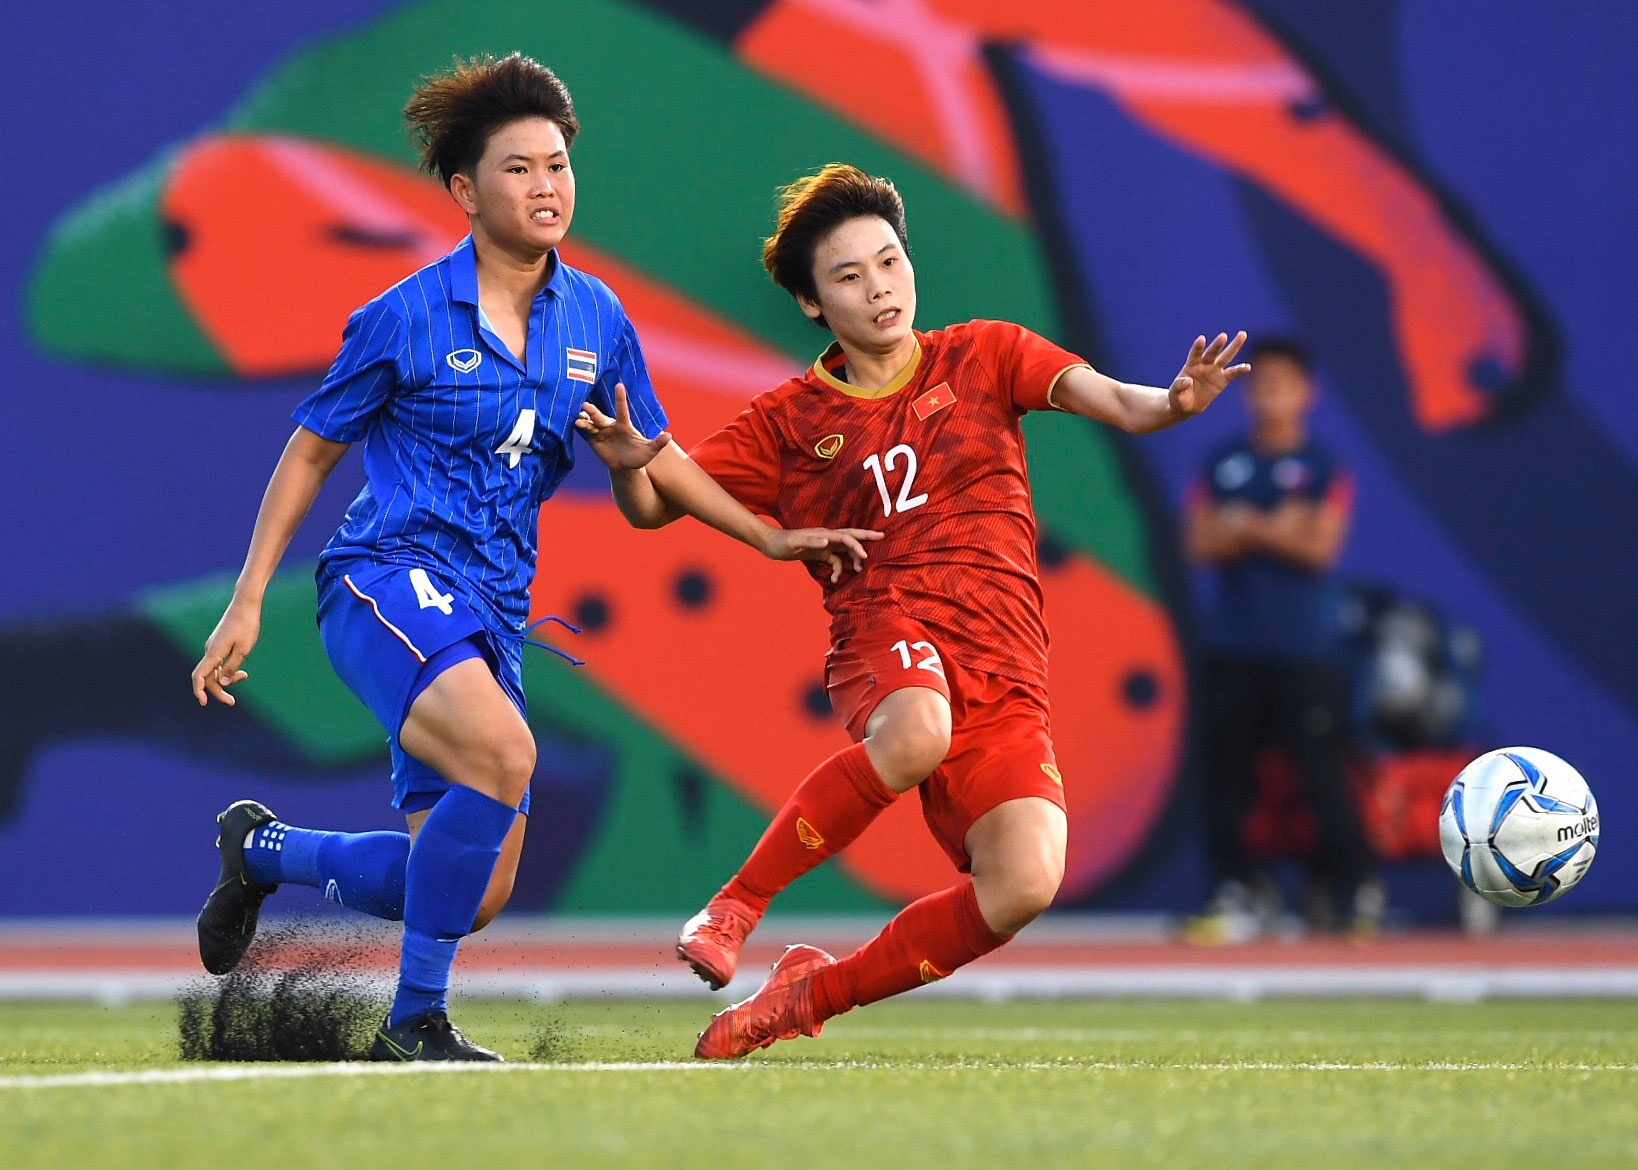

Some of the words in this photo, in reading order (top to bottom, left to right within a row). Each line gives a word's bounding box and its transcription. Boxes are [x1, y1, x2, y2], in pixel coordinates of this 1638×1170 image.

[494, 408, 536, 469] 4
[862, 443, 929, 518] 12
[408, 568, 455, 616] 4
[889, 639, 947, 681] 12
[1557, 814, 1598, 842] molte
